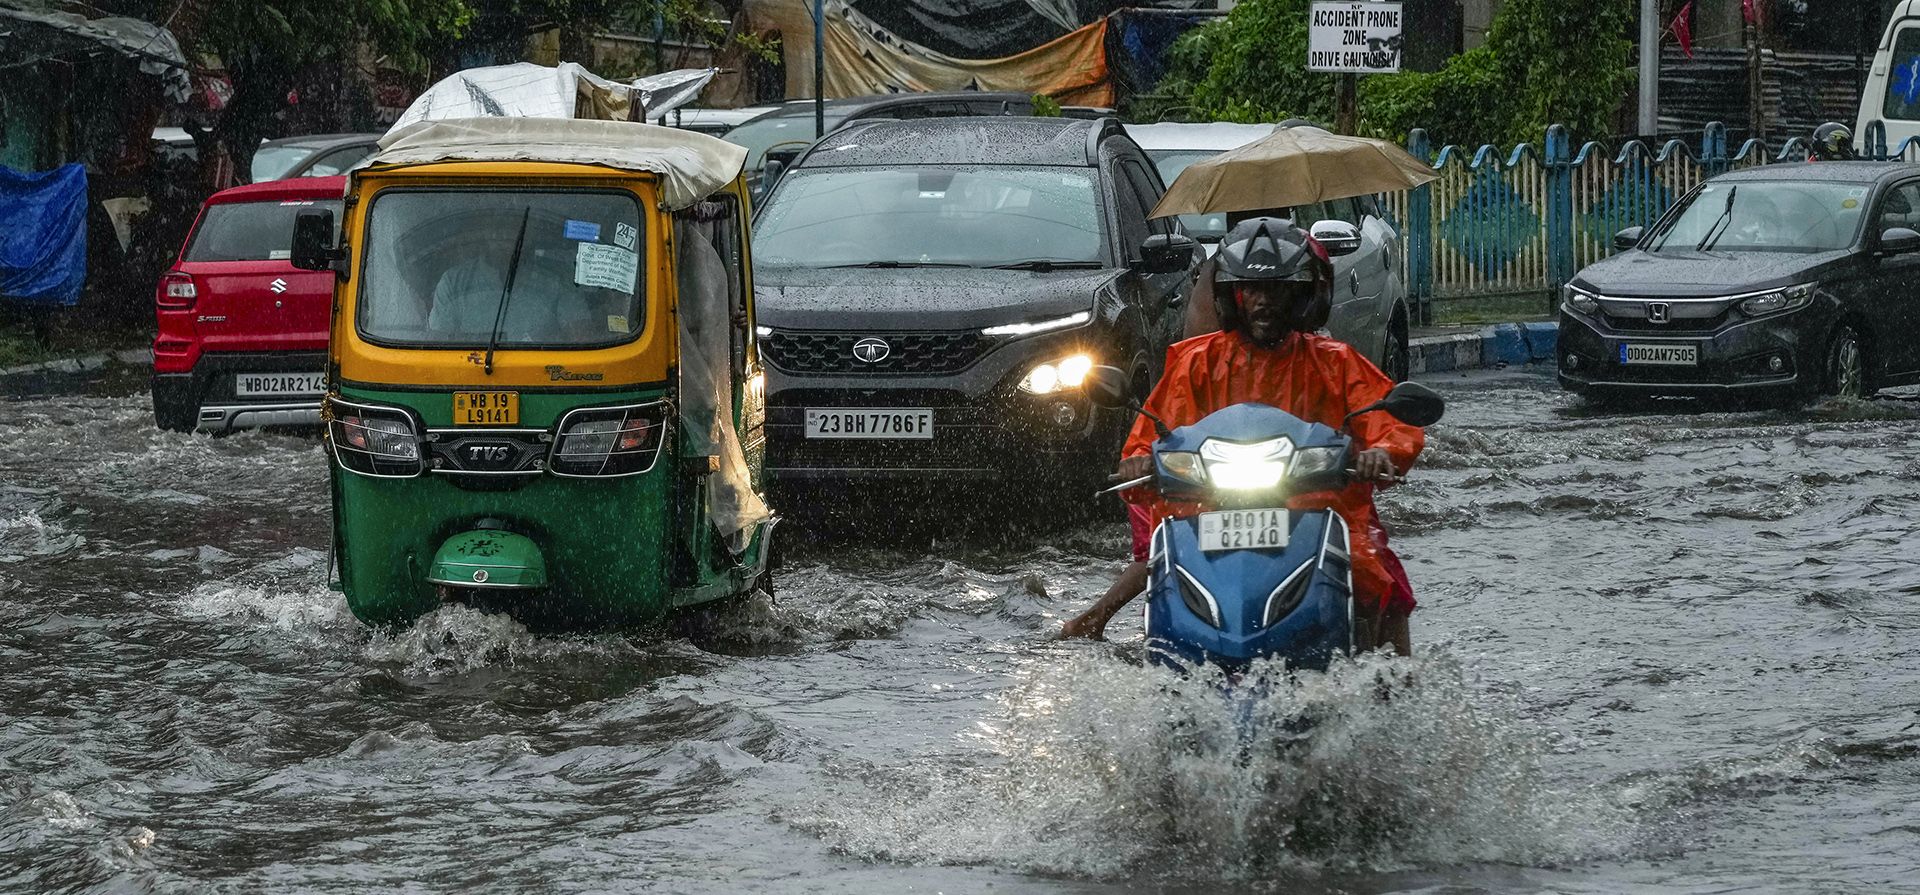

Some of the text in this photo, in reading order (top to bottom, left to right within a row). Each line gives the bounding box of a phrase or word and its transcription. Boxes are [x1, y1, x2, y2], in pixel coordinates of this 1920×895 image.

[1313, 10, 1399, 28] ACCIDENT PRONE
[1342, 29, 1367, 46] ZONE
[1311, 51, 1340, 67] DRIVE
[1627, 347, 1695, 361] OD02AW7505
[470, 394, 508, 408] WB 19
[468, 409, 509, 423] L9141
[819, 414, 928, 433] 23 BH 7786 F
[469, 446, 509, 461] TVS
[1221, 511, 1279, 529] WB01A
